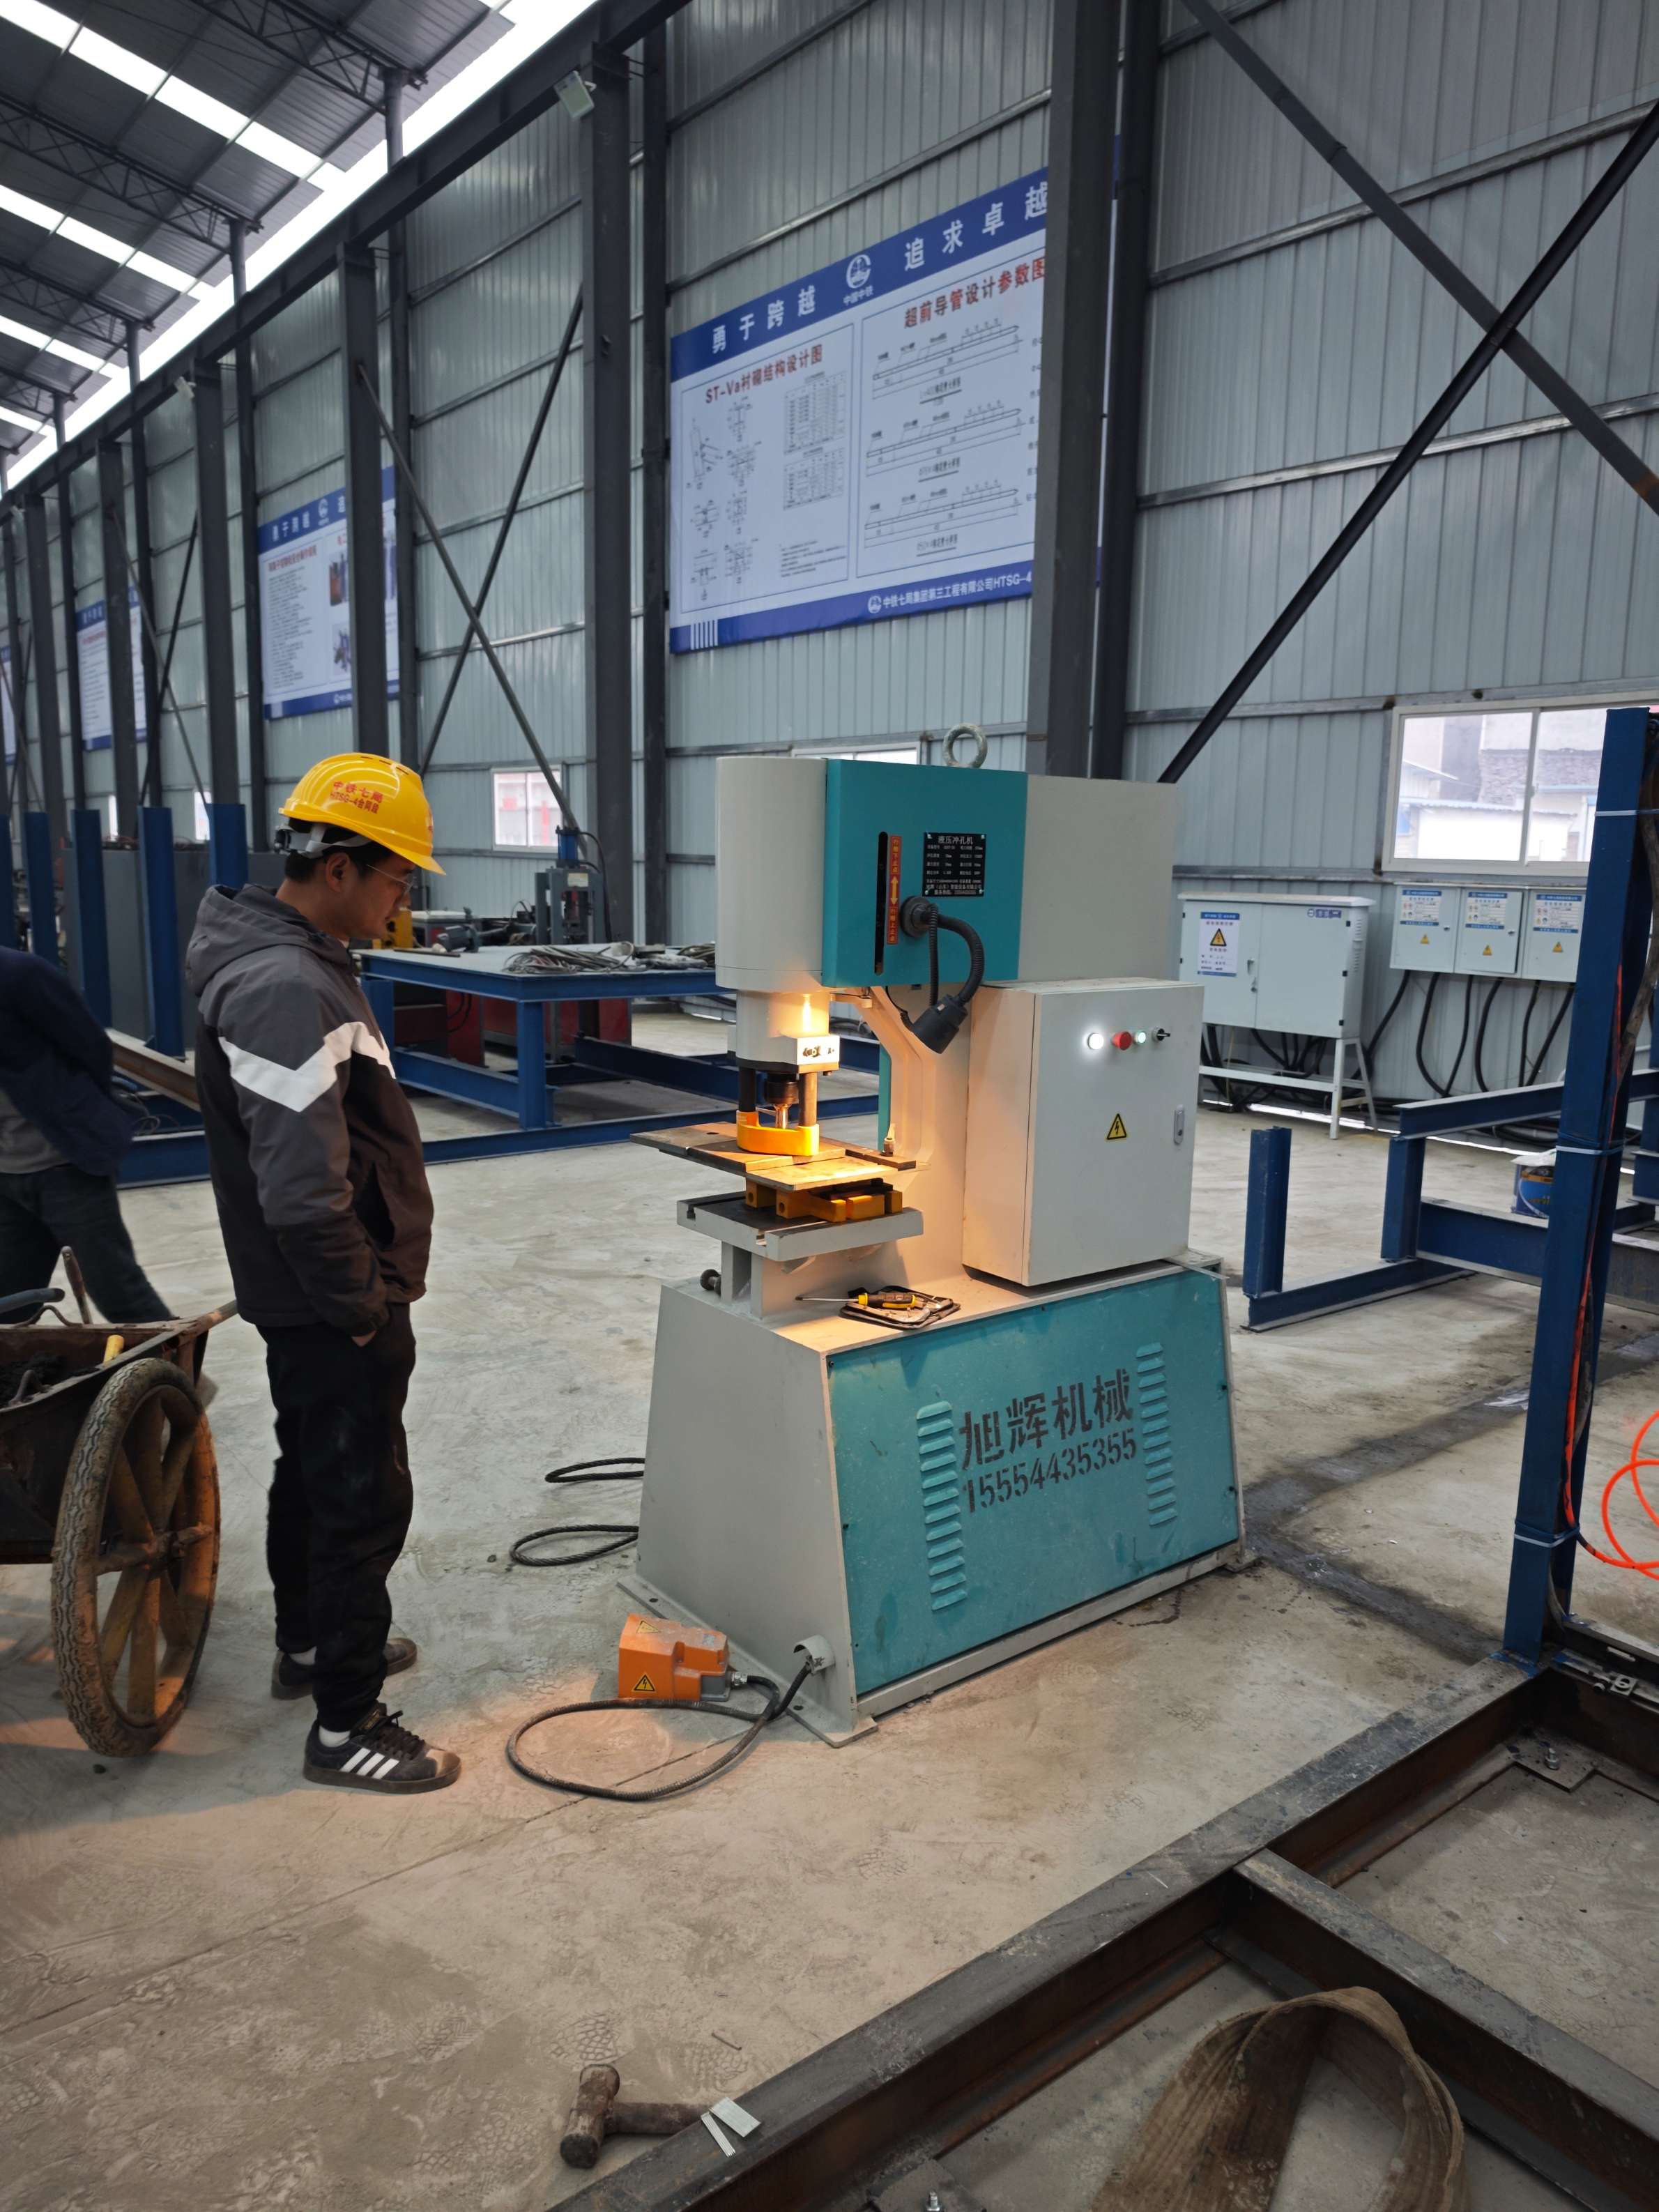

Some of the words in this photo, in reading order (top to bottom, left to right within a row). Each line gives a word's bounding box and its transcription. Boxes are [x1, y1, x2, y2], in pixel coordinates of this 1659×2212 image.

[904, 181, 1048, 271] 追求卓越
[712, 284, 816, 354] 勇于跨越
[904, 256, 1046, 328] 超前导管设计参数图
[958, 1368, 1133, 1471] 旭辉机械
[962, 1428, 1138, 1513] 15554435355
